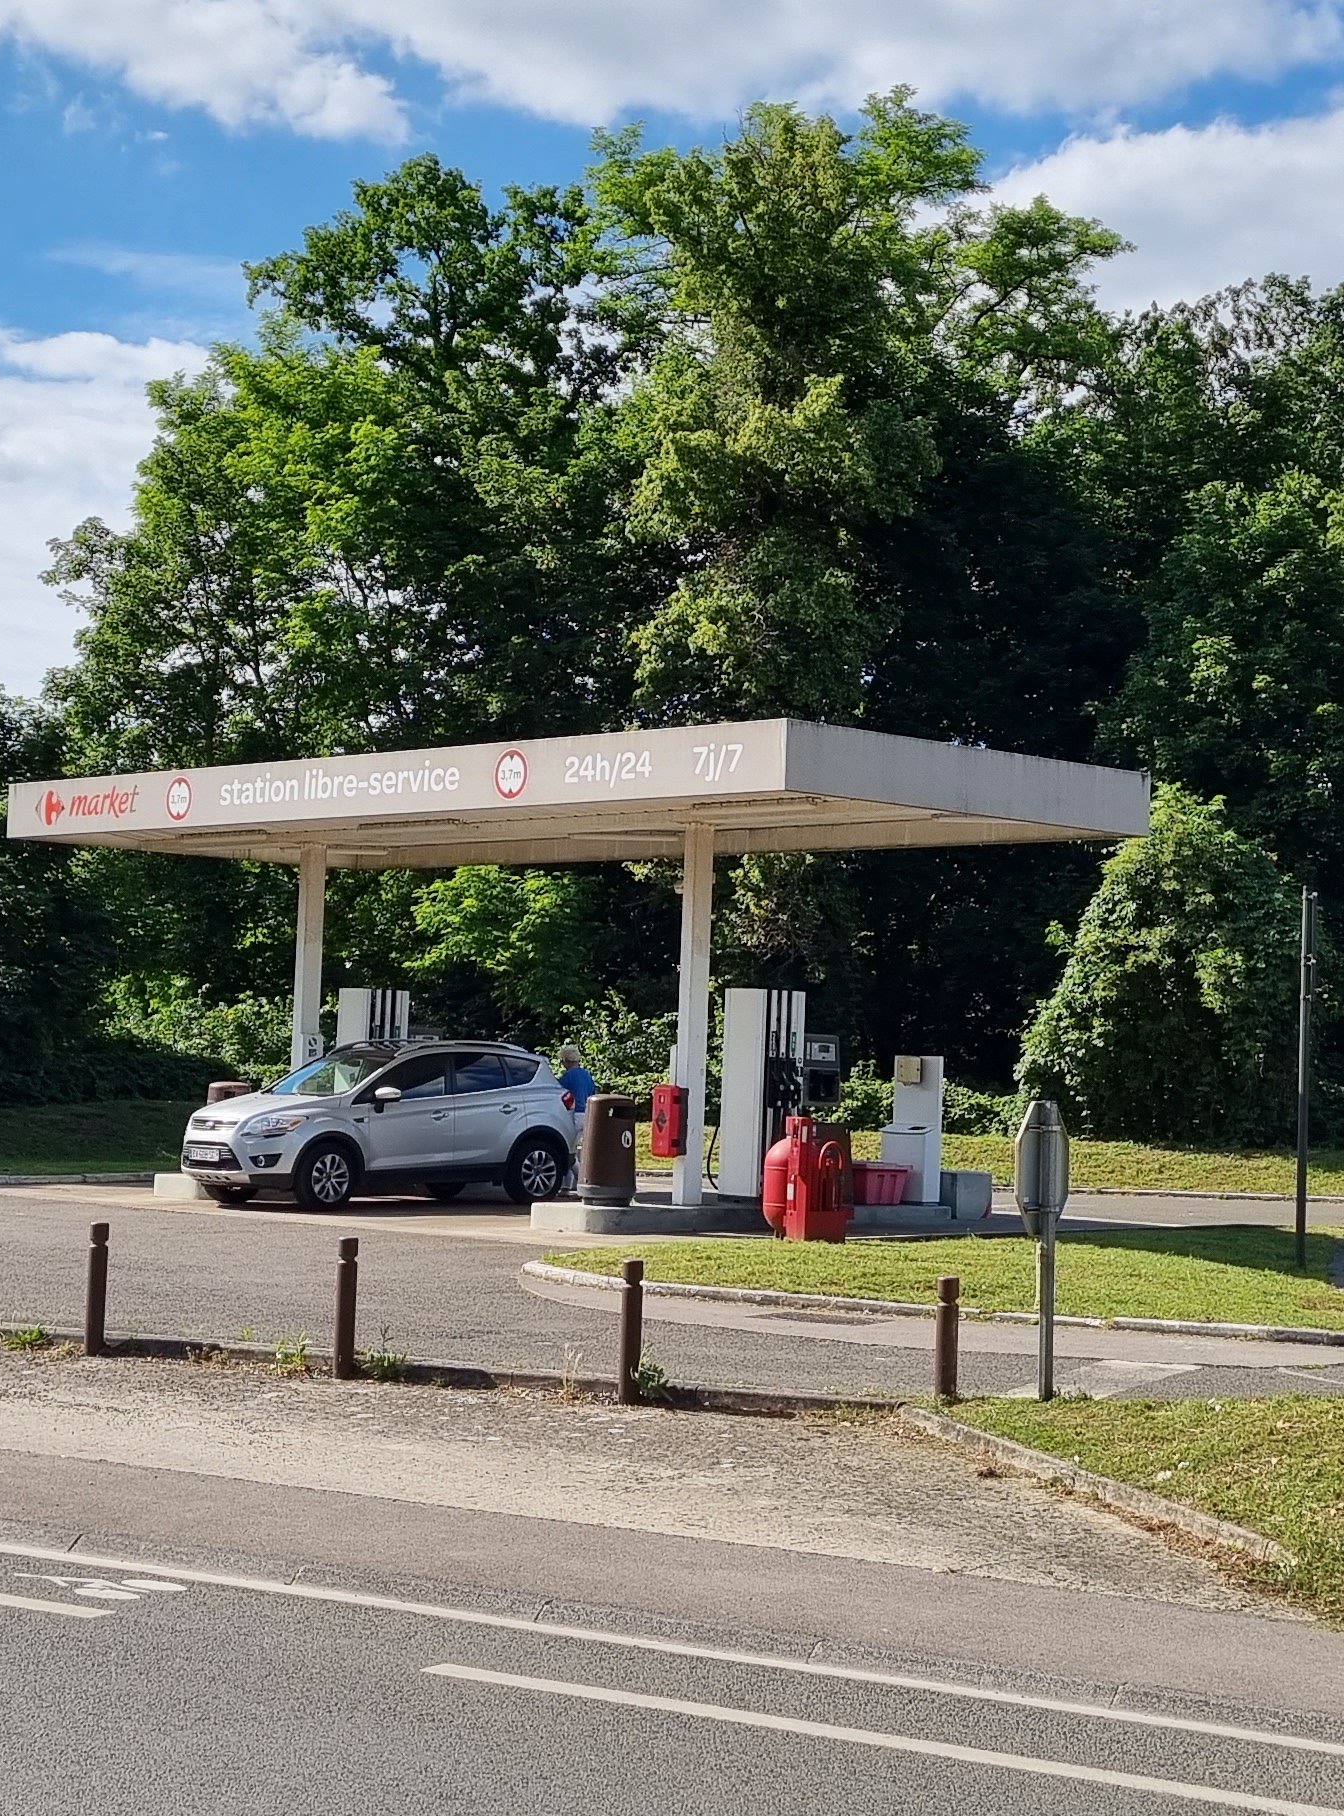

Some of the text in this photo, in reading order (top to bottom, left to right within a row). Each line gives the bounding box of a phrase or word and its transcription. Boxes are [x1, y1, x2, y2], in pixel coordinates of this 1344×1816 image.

[219, 759, 460, 806] station libre-service
[500, 769, 522, 782] 3,7m
[564, 743, 744, 788] 24h/24 7j/7
[69, 784, 140, 819] market
